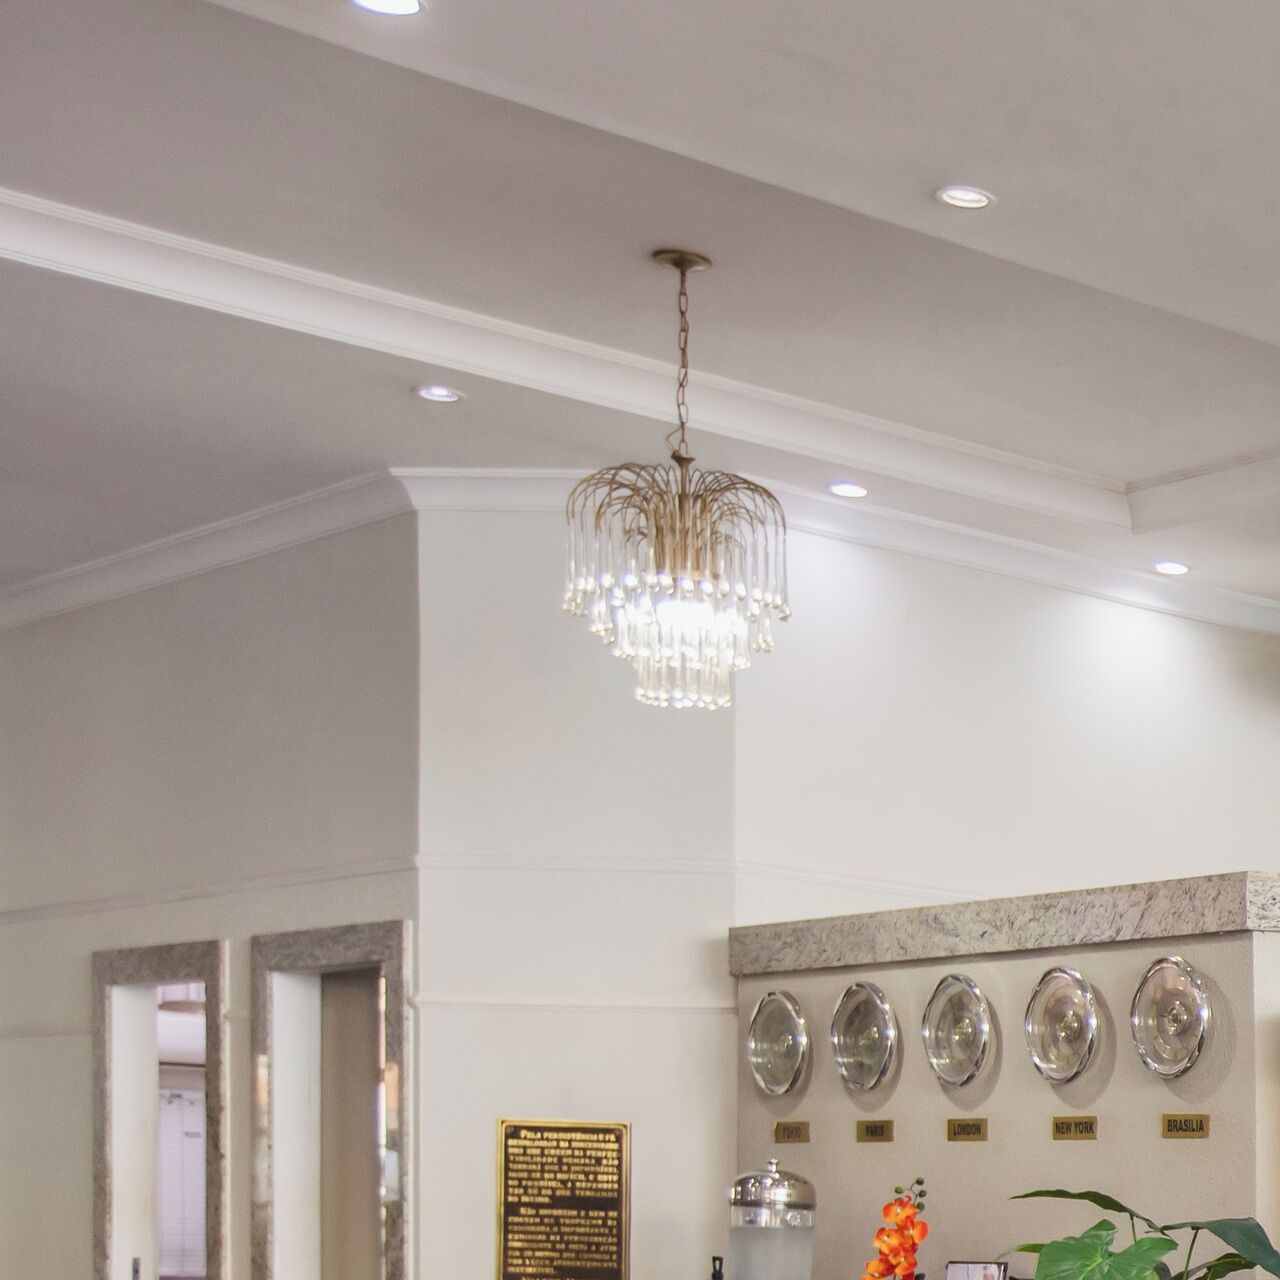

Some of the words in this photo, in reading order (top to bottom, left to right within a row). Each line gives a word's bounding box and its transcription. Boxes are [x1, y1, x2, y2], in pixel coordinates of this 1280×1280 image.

[866, 1124, 885, 1137] PARIS
[953, 1123, 982, 1136] LONDON
[1055, 1121, 1073, 1134] NEW
[1074, 1121, 1094, 1134] YORK
